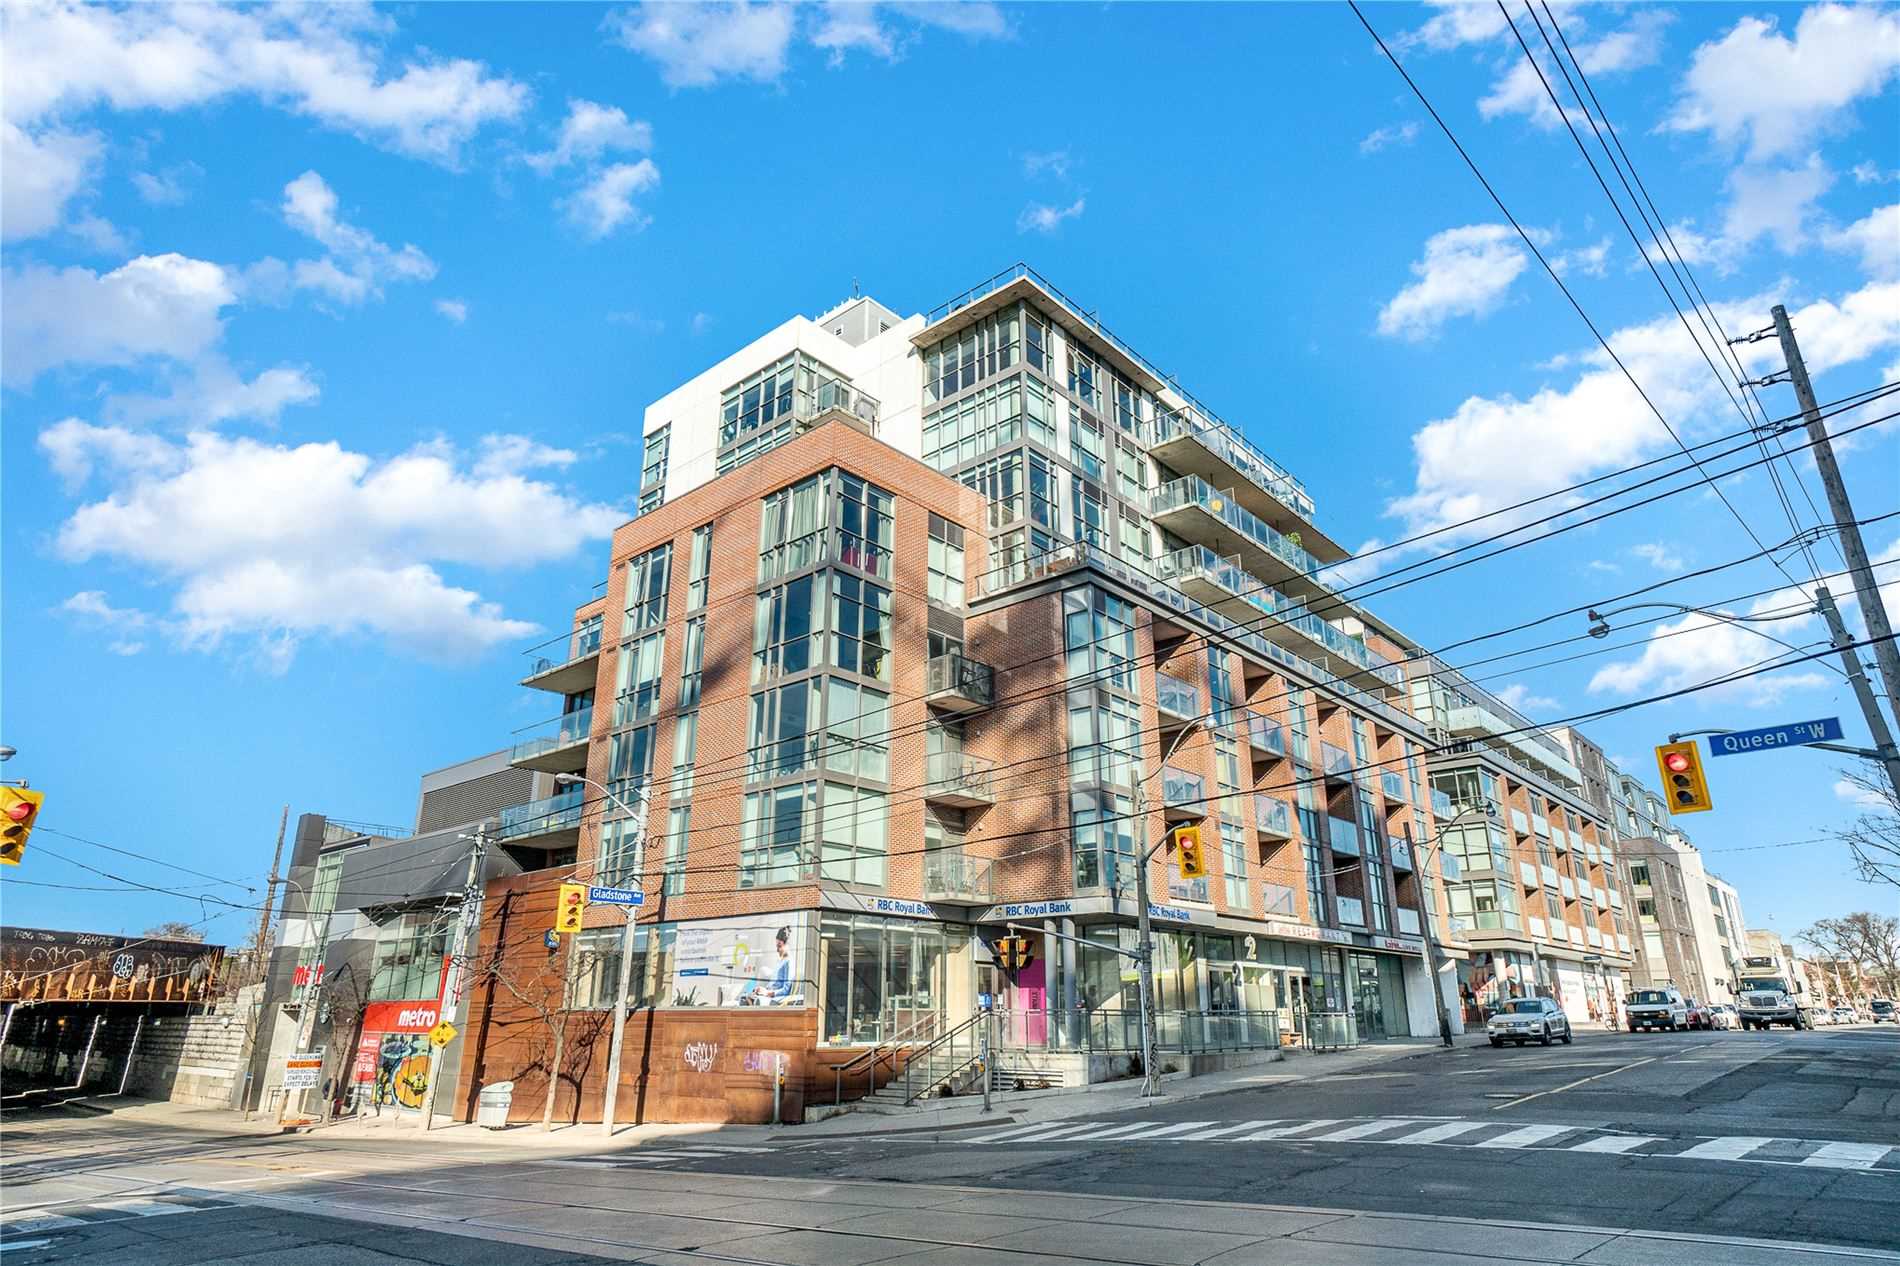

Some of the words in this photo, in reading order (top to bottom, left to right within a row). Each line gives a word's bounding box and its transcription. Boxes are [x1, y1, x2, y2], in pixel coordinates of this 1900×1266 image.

[1723, 731, 1788, 752] Queen
[1793, 725, 1805, 735] St
[1808, 722, 1825, 738] W
[592, 888, 632, 902] Gladstone
[877, 899, 893, 912] RBC
[894, 902, 915, 915] Royal
[1006, 905, 1022, 917] RBC
[1024, 903, 1047, 916] Royal
[1049, 901, 1071, 913] Bank
[1161, 905, 1176, 920] Royal
[1177, 908, 1191, 921] Bank
[1244, 934, 1257, 960] 2
[398, 1008, 436, 1027] metro
